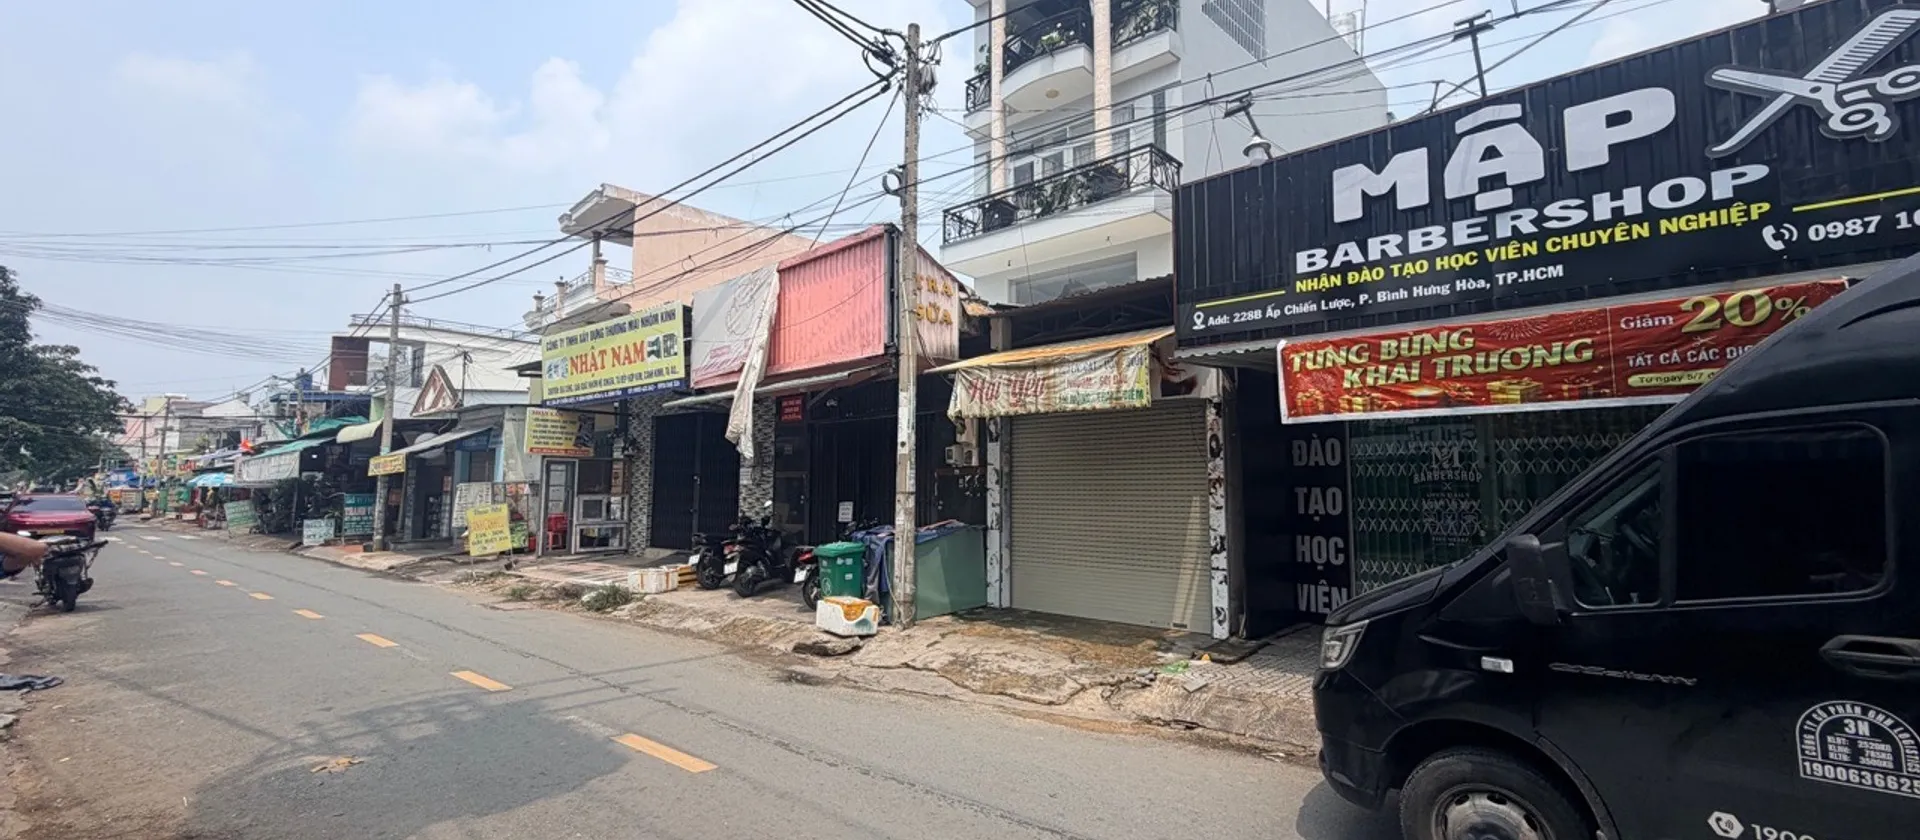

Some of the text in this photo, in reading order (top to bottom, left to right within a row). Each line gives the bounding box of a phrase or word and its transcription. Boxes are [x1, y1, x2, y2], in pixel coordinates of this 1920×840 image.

[1332, 87, 1676, 224] MẬP
[1296, 164, 1770, 274] BARBERSHOP
[1808, 214, 1883, 242] 0987
[1296, 202, 1772, 293] NHẬN ĐÀO TẠO HỌC VIÊN CHUYÊN NGHIỆP
[1207, 264, 1564, 326] Add: 228B Ấp Chiến Lược, P. Bình Hưng Hòa, TP.HCM
[1620, 313, 1674, 331] Giảm
[569, 340, 645, 377] NHẬT NAM
[1342, 338, 1594, 389] KHAI TRƯƠNG
[1626, 351, 1654, 368] TẤT
[1687, 346, 1720, 362] CÁC
[1291, 433, 1342, 467] ĐÀO
[1413, 469, 1483, 485] BARBERSHOP
[1294, 486, 1343, 522] TẠO
[1296, 535, 1345, 571] HỌC
[1297, 579, 1348, 614] VIÊN
